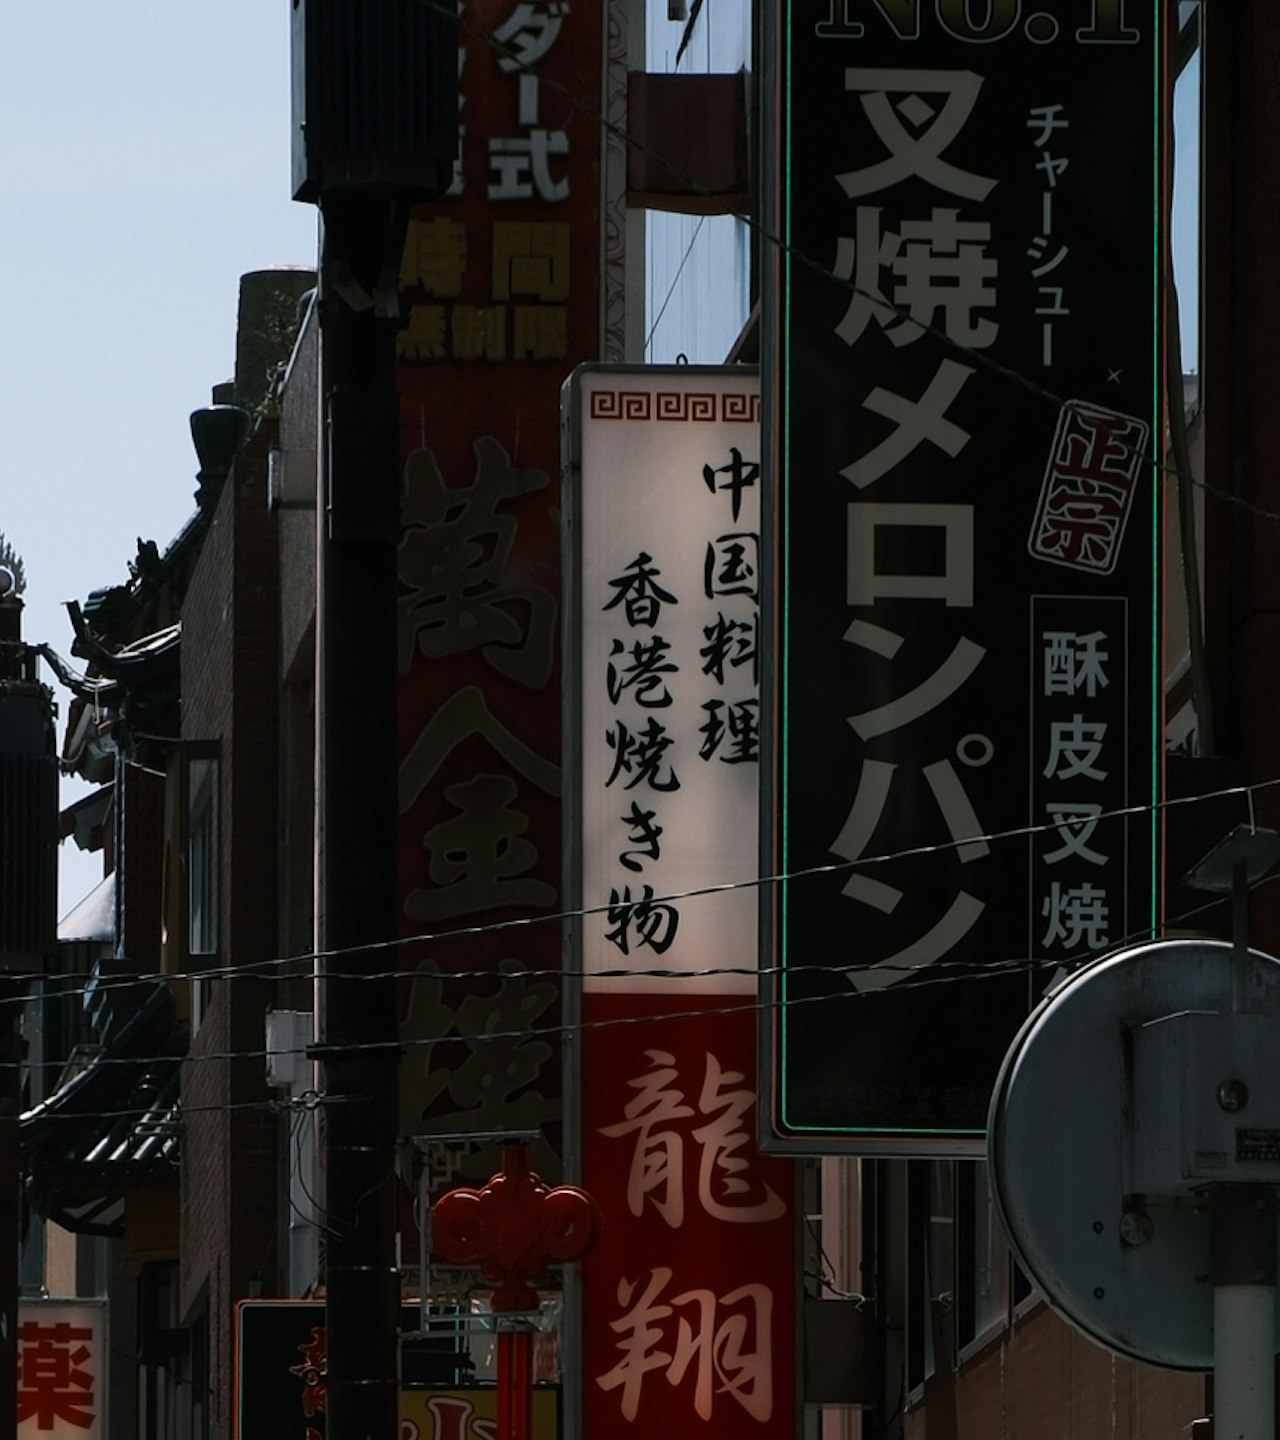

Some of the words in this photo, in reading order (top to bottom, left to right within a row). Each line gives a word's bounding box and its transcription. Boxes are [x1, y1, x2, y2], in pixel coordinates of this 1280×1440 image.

[1025, 102, 1071, 368] チャーシュー
[700, 447, 761, 766] 中国料理
[828, 67, 1000, 996] 叉焼メロンパン
[602, 553, 681, 957] 香港焼き物
[1040, 628, 1111, 1002] 酥皮叉焼
[16, 1321, 95, 1431] 薬
[595, 1049, 787, 1424] 龍翔
